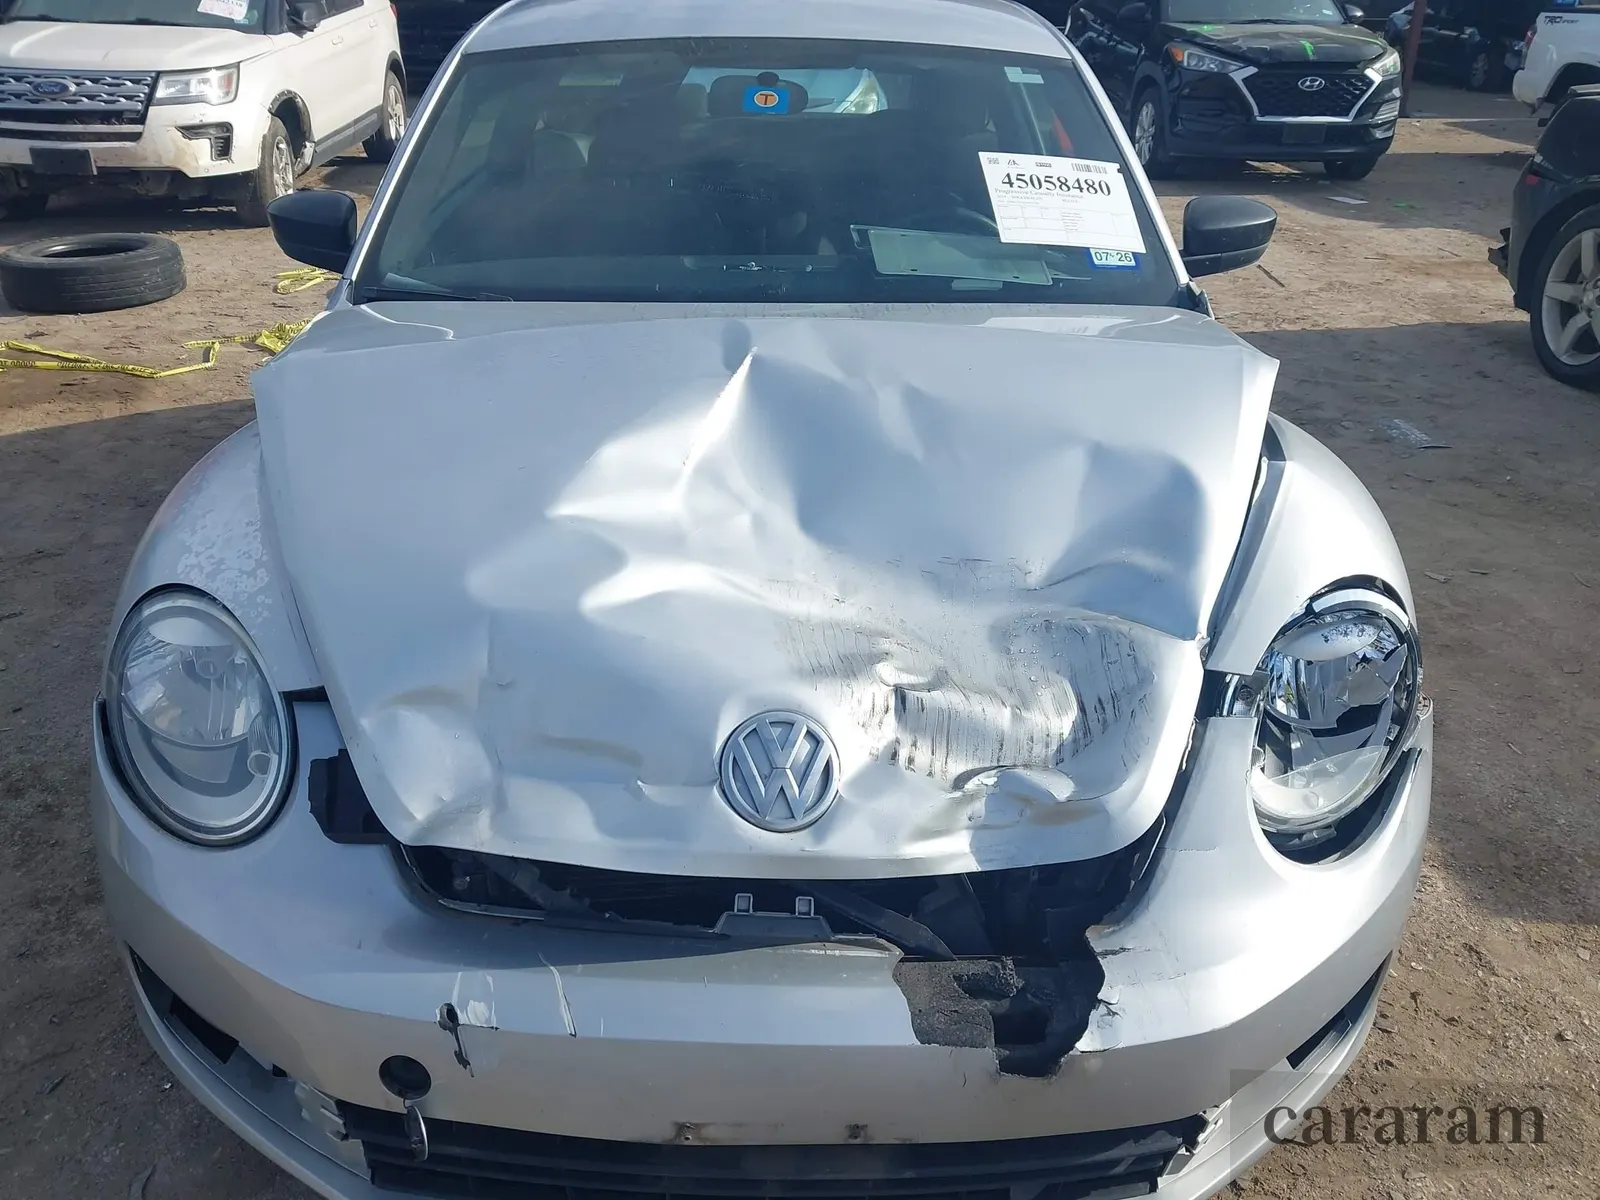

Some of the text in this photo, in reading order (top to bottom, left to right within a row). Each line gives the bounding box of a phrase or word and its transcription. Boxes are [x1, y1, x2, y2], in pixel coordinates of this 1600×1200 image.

[759, 93, 775, 105] T
[1001, 172, 1112, 197] 45058480
[1115, 252, 1132, 262] 26
